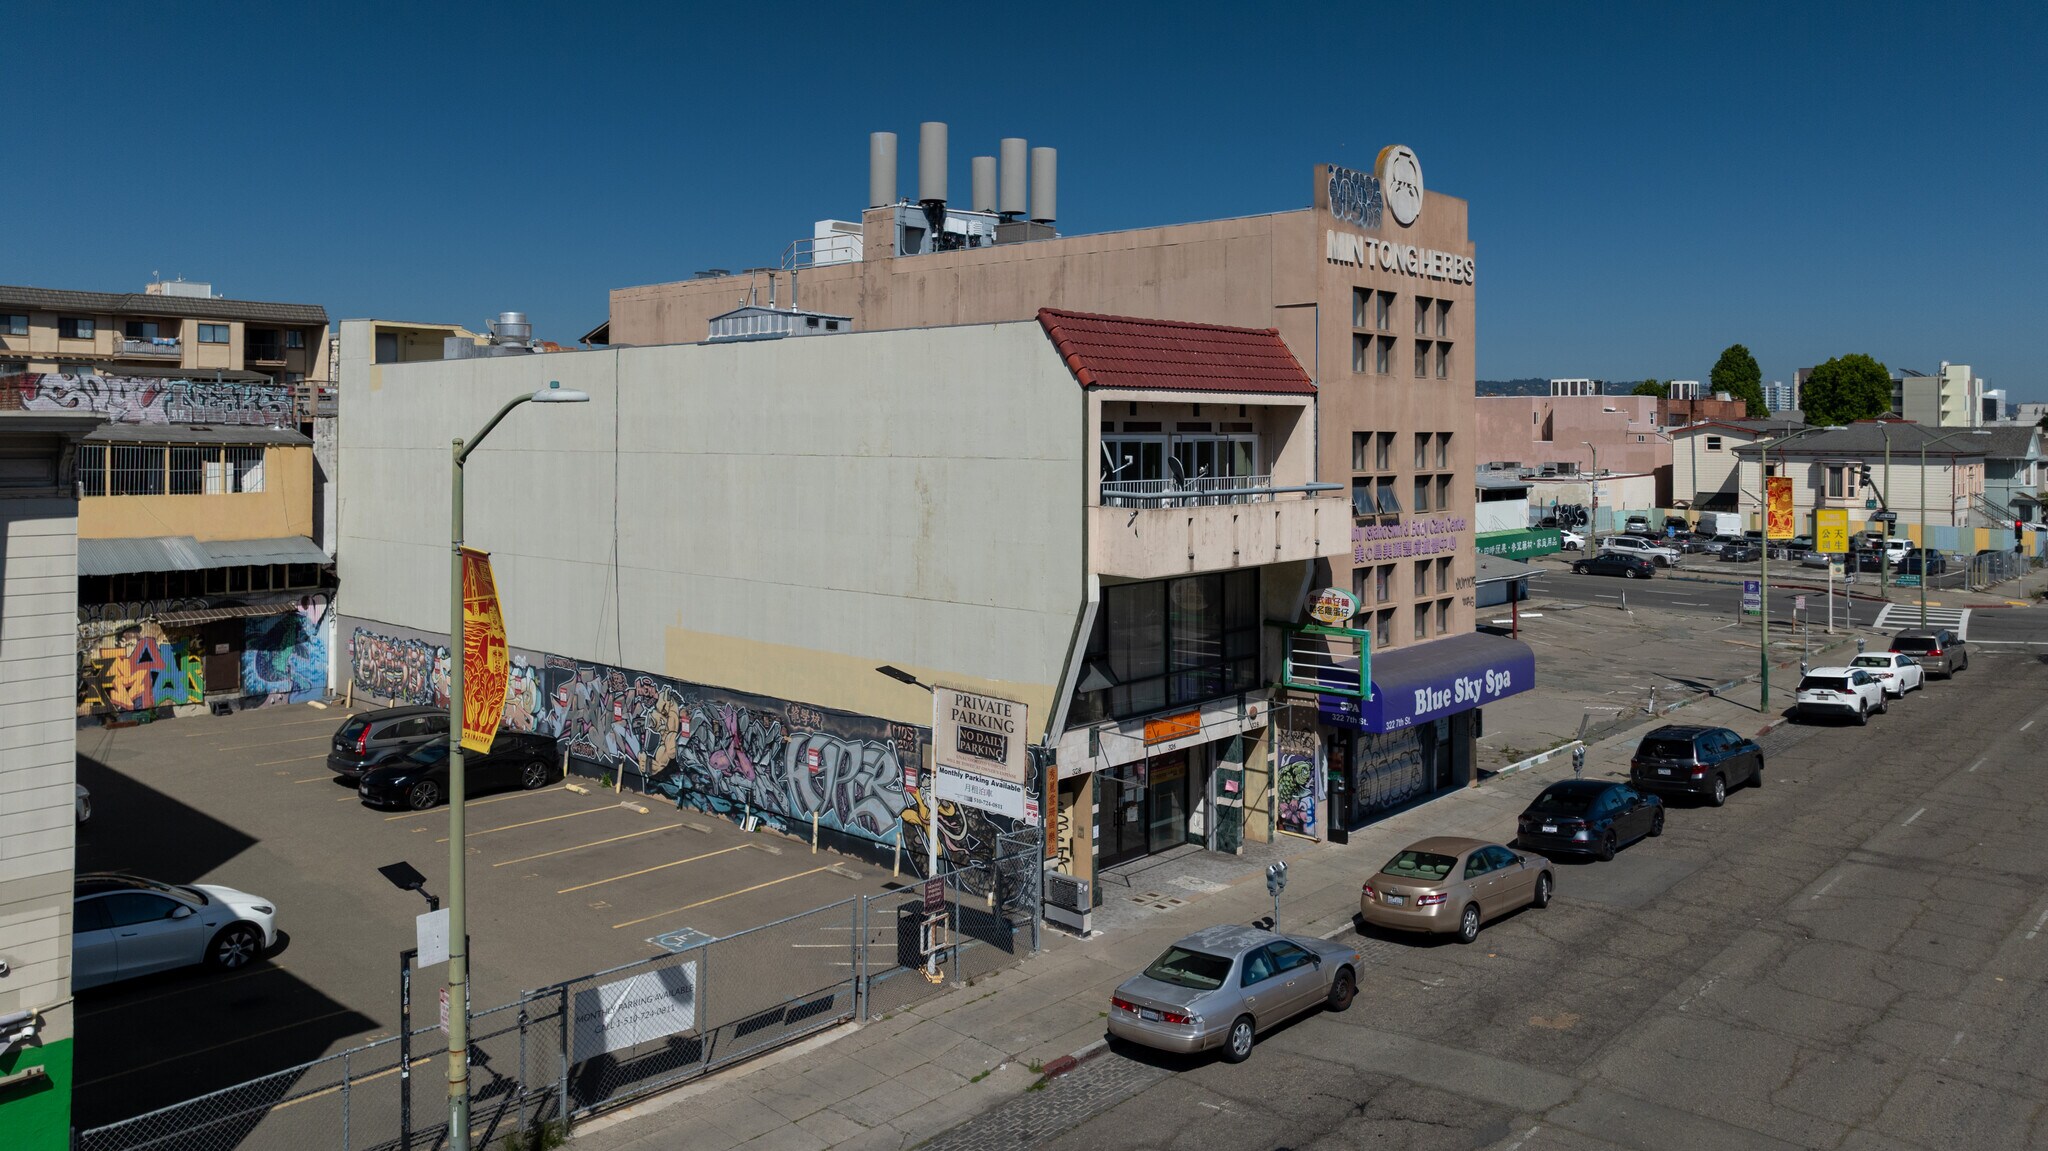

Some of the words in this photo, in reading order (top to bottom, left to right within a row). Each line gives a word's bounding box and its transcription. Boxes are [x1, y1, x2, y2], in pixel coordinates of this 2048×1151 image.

[1327, 230, 1364, 266] MIN
[1365, 237, 1419, 276] TONG
[1419, 247, 1475, 284] HERBS
[1411, 519, 1428, 538] Body
[1429, 518, 1446, 534] Care
[1446, 516, 1466, 532] Center
[1414, 686, 1452, 716] Blue
[1454, 675, 1483, 704] Sky
[1485, 668, 1511, 697] Spa
[955, 693, 1012, 718] PRIVATE
[1340, 702, 1360, 713] SPA
[951, 708, 1015, 734] PARKING
[1332, 713, 1345, 722] 322
[1346, 715, 1358, 724] 7th
[1359, 717, 1369, 726] St.
[1385, 720, 1396, 731] 322
[1395, 718, 1404, 728] 7th
[1404, 716, 1412, 725] St.
[960, 729, 975, 741] NO
[976, 733, 1005, 747] DAILY
[960, 740, 1004, 759] PARKING
[938, 767, 964, 780] Monthly
[965, 774, 990, 786] Parking
[991, 778, 1021, 793] Available
[575, 1005, 616, 1024] MONTHLY
[618, 995, 655, 1012] PARKING
[654, 984, 695, 1002] AVAILABLE
[594, 1021, 615, 1034] CALL
